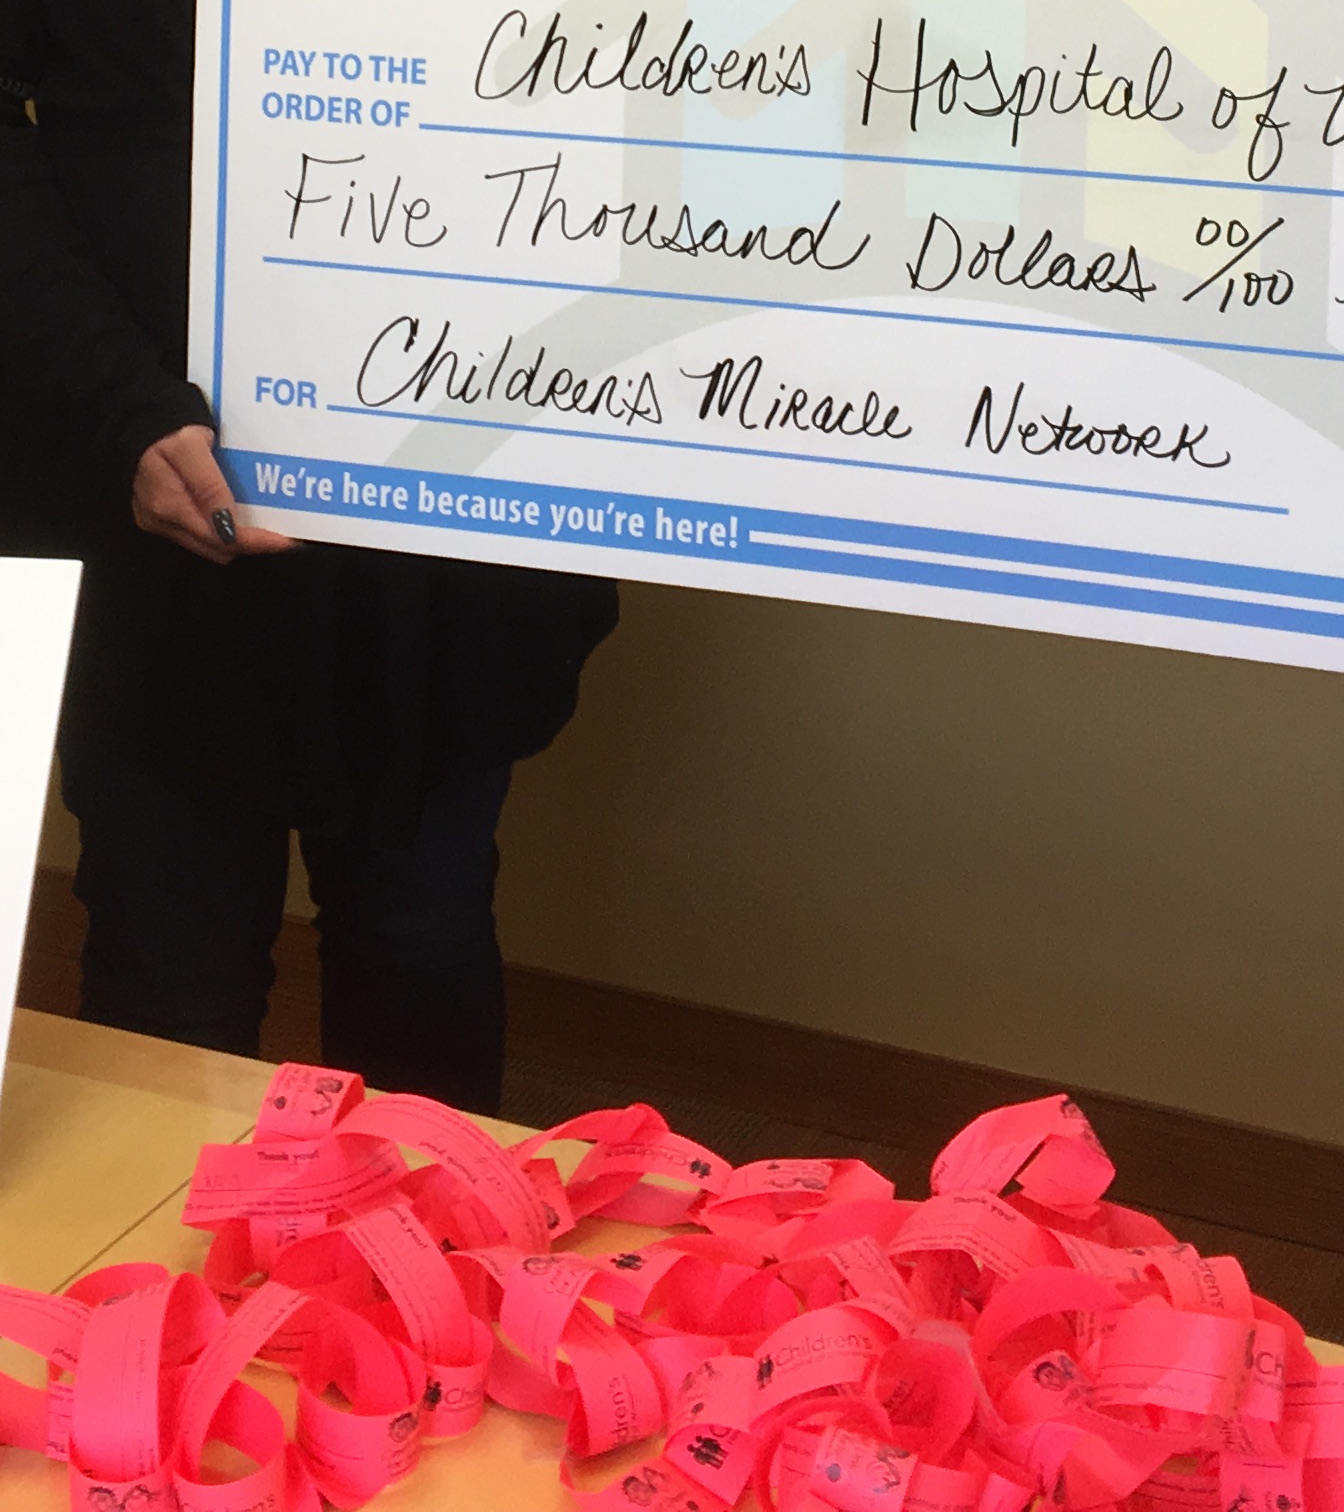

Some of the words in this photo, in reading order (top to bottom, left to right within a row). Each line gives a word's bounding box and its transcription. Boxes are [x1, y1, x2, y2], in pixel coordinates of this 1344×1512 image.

[261, 91, 363, 125] ORDER
[370, 100, 411, 129] OF
[263, 48, 316, 77] PAY
[323, 51, 363, 81] TO
[369, 54, 428, 86] THE
[475, 9, 811, 100] Children's
[856, 18, 1185, 147] Hospital
[1211, 67, 1292, 181] of
[284, 152, 448, 247] Five
[484, 152, 871, 270] Thousand
[906, 212, 1157, 302] Dollars
[255, 375, 318, 410] FOR
[355, 315, 664, 426] Children's
[679, 354, 913, 439] Miracle
[966, 384, 1232, 469] Network
[255, 461, 333, 501] We're
[342, 472, 408, 511] here
[417, 480, 541, 526] because
[550, 501, 645, 538] you're
[655, 506, 739, 549] here!
